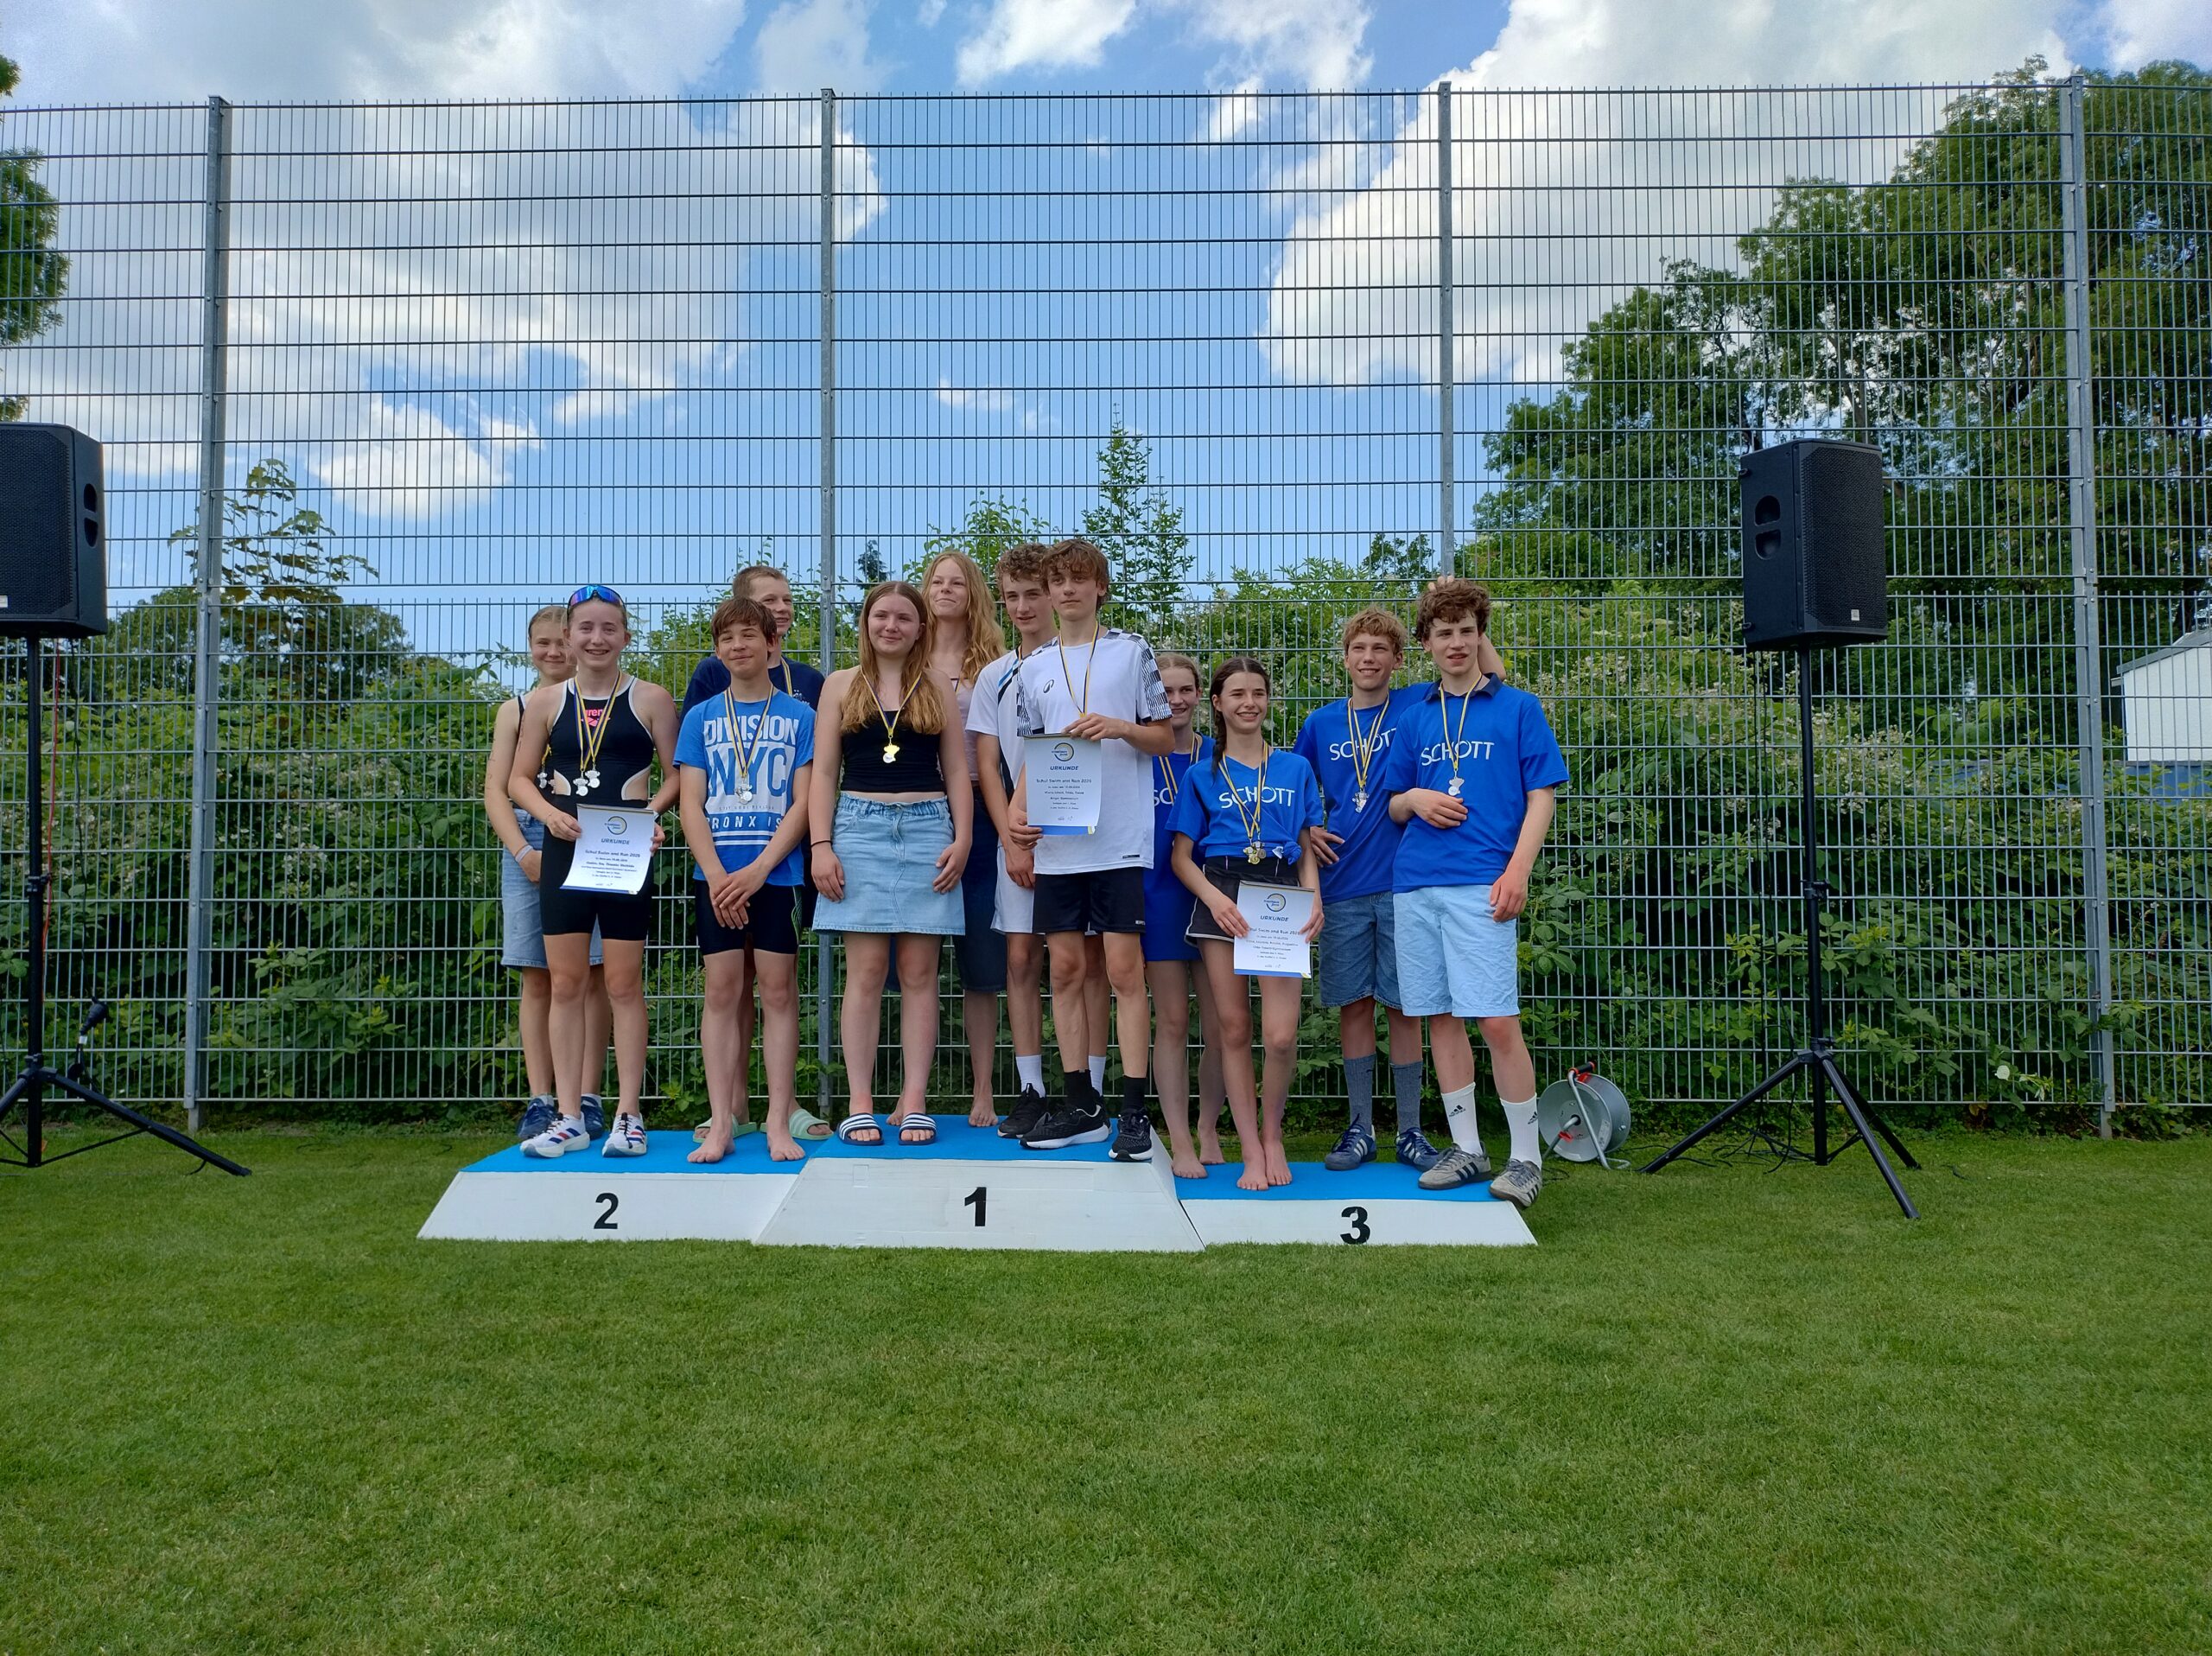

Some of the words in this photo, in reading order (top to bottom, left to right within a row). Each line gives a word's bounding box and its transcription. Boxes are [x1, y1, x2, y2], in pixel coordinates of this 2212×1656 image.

[703, 715, 799, 746] DIVISION
[1421, 739, 1495, 767] SCHOTT
[708, 746, 787, 797] NYC
[1218, 786, 1295, 809] SCHOTT
[707, 816, 756, 830] RONX
[594, 1192, 619, 1229] 2
[964, 1187, 987, 1227] 1
[1340, 1207, 1370, 1245] 3
